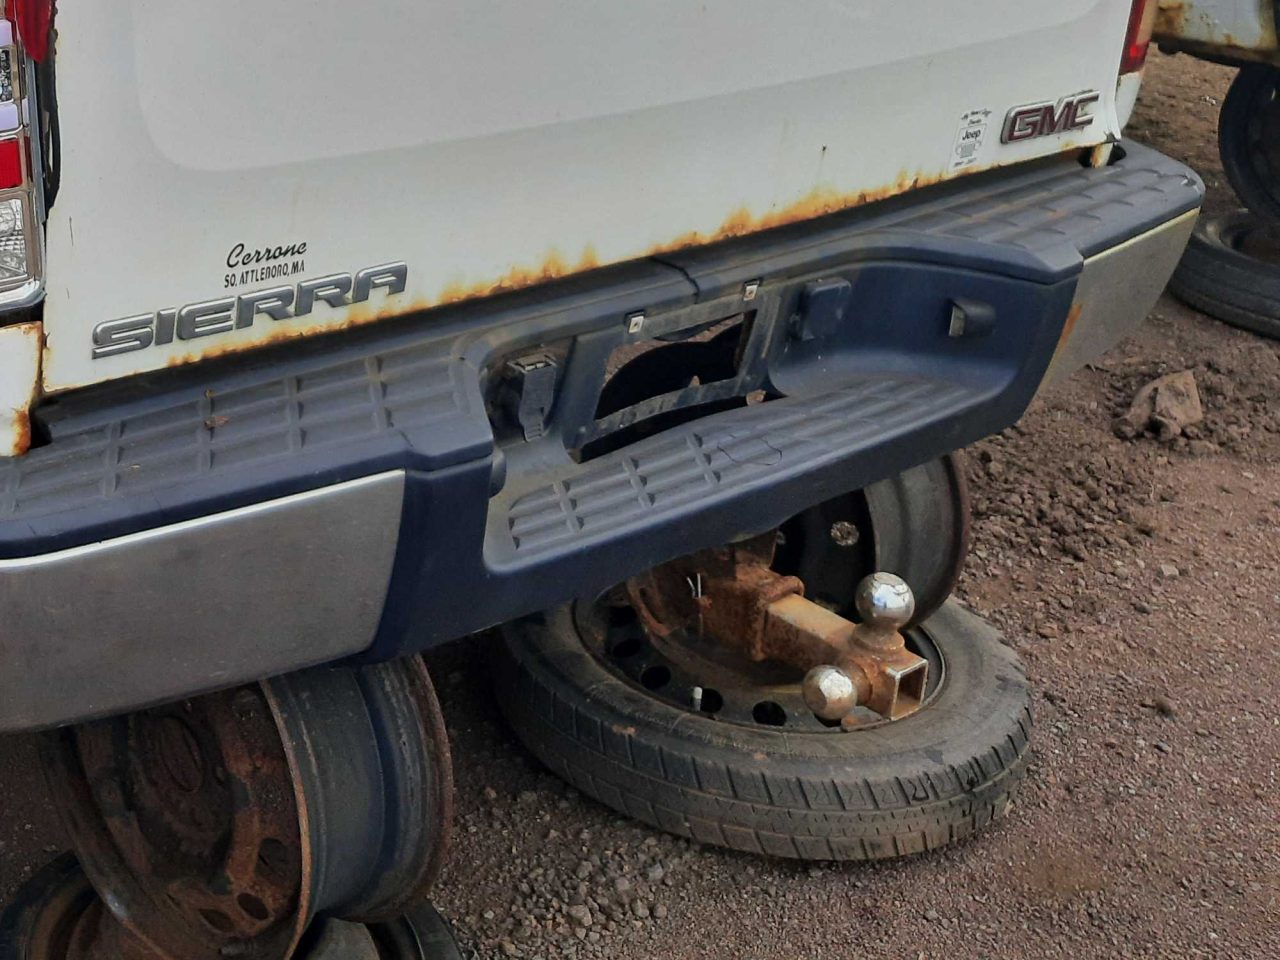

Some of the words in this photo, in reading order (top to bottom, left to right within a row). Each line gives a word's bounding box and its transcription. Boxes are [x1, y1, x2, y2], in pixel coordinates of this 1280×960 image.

[1000, 89, 1101, 145] GMC
[226, 242, 307, 269] Cerrone
[223, 273, 238, 289] SO.
[91, 259, 408, 360] SIERRA
